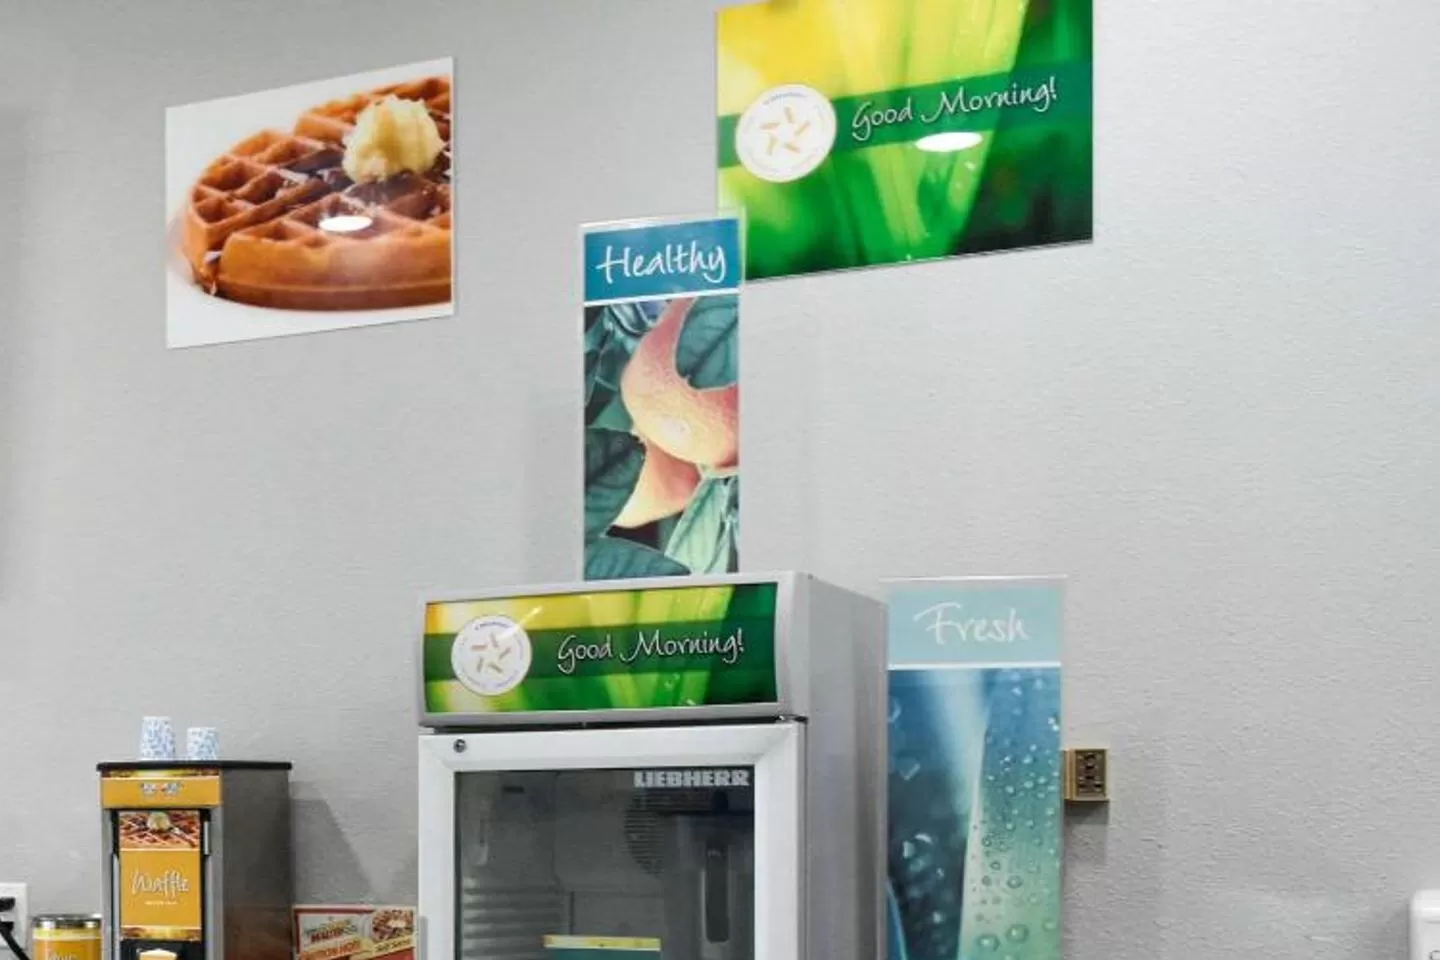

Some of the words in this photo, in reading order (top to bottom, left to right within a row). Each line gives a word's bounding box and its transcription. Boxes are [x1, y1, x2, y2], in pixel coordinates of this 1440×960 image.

[851, 97, 913, 141] Good
[920, 76, 1057, 124] Morning!
[595, 240, 727, 284] Healthy
[912, 601, 1031, 645] Fresh
[557, 634, 613, 675] Good
[619, 628, 745, 663] Morning!
[633, 769, 751, 788] LIEBHERR
[131, 868, 189, 899] Waffle
